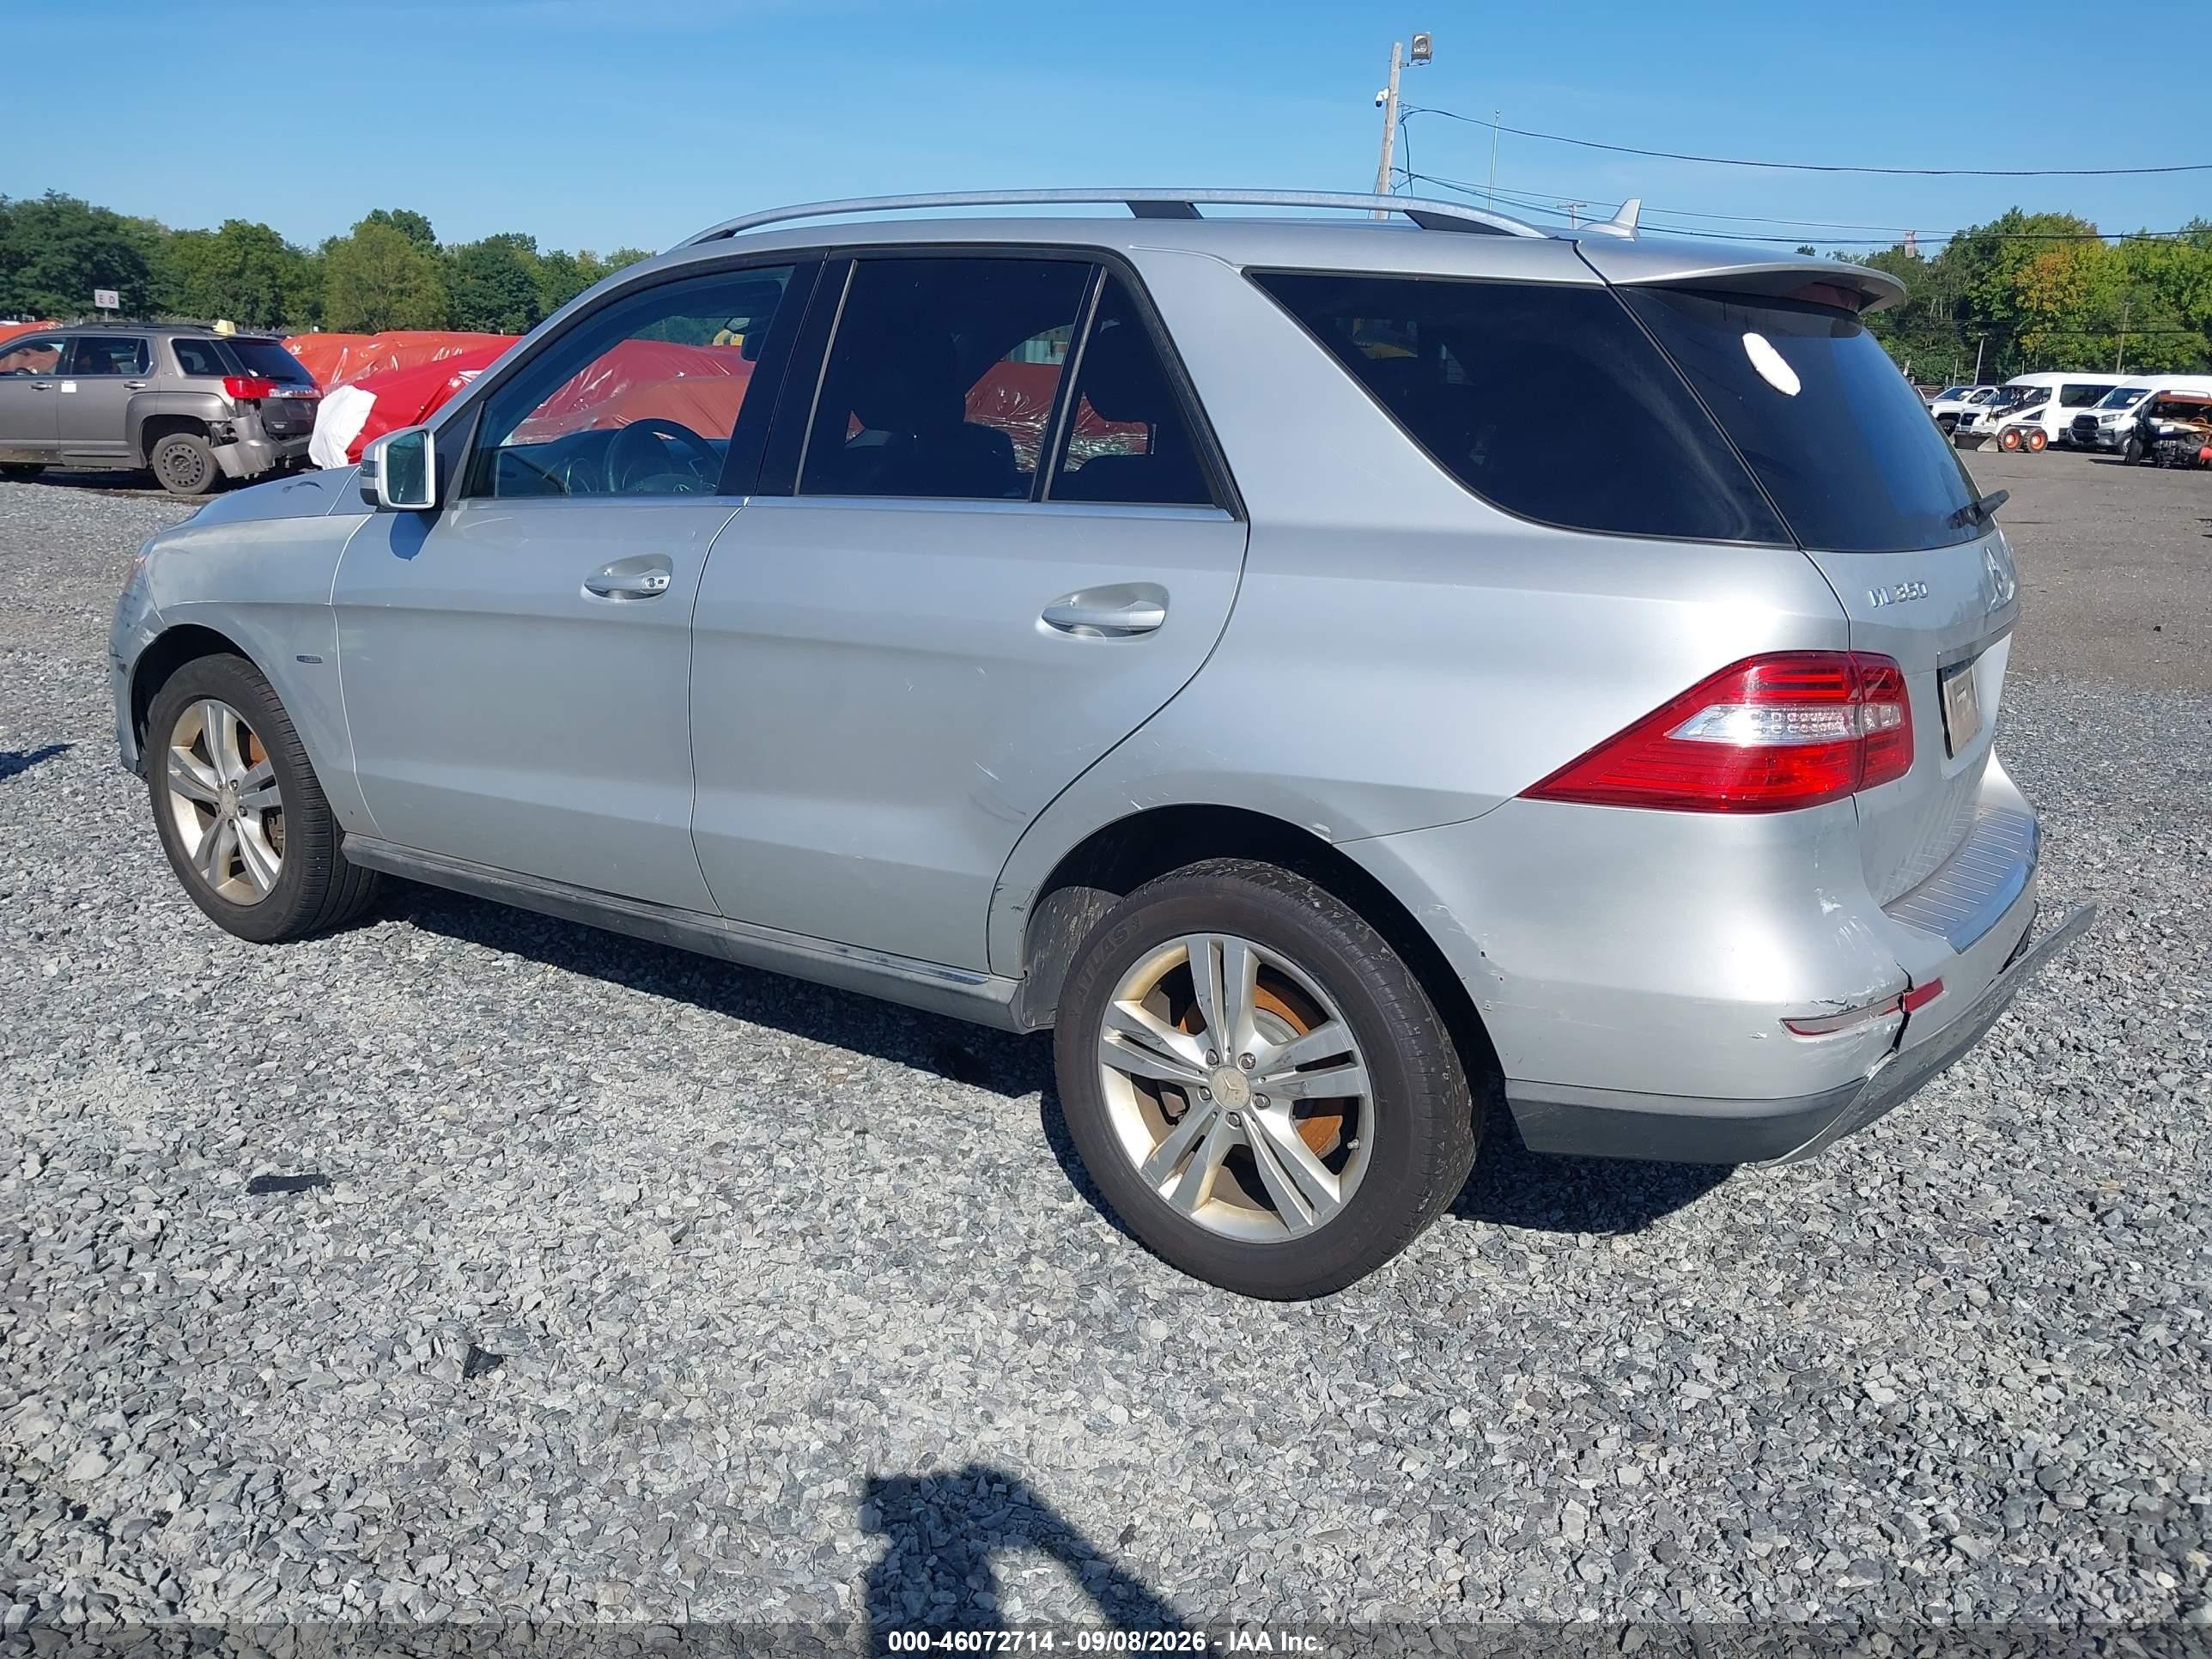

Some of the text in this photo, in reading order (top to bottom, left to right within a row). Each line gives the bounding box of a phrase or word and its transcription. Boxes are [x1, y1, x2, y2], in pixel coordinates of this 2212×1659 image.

[109, 295, 116, 305] D
[1869, 581, 1929, 608] ML 350
